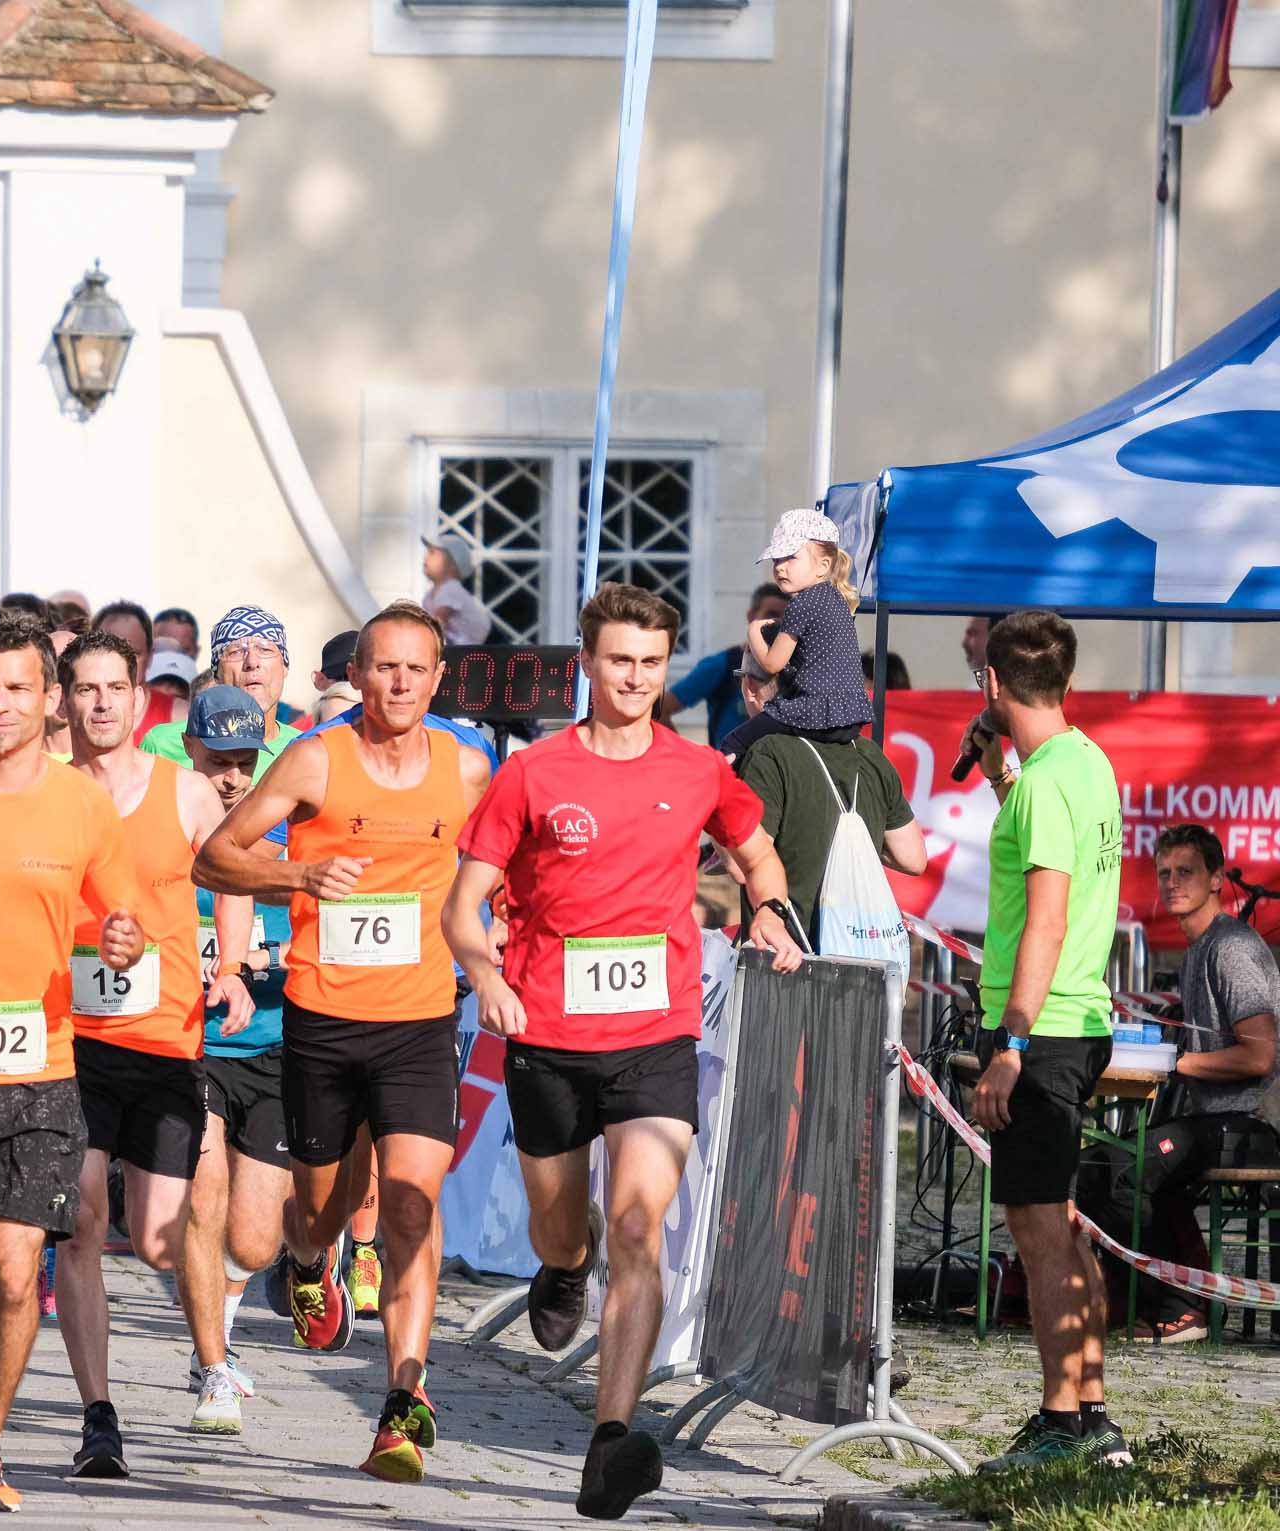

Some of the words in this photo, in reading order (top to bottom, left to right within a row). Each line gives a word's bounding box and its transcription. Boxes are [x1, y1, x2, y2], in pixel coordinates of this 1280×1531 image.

[553, 818, 588, 833] LAC
[350, 916, 391, 945] 76
[93, 968, 131, 996] 15
[587, 960, 646, 992] 103
[1091, 1404, 1106, 1412] PU
